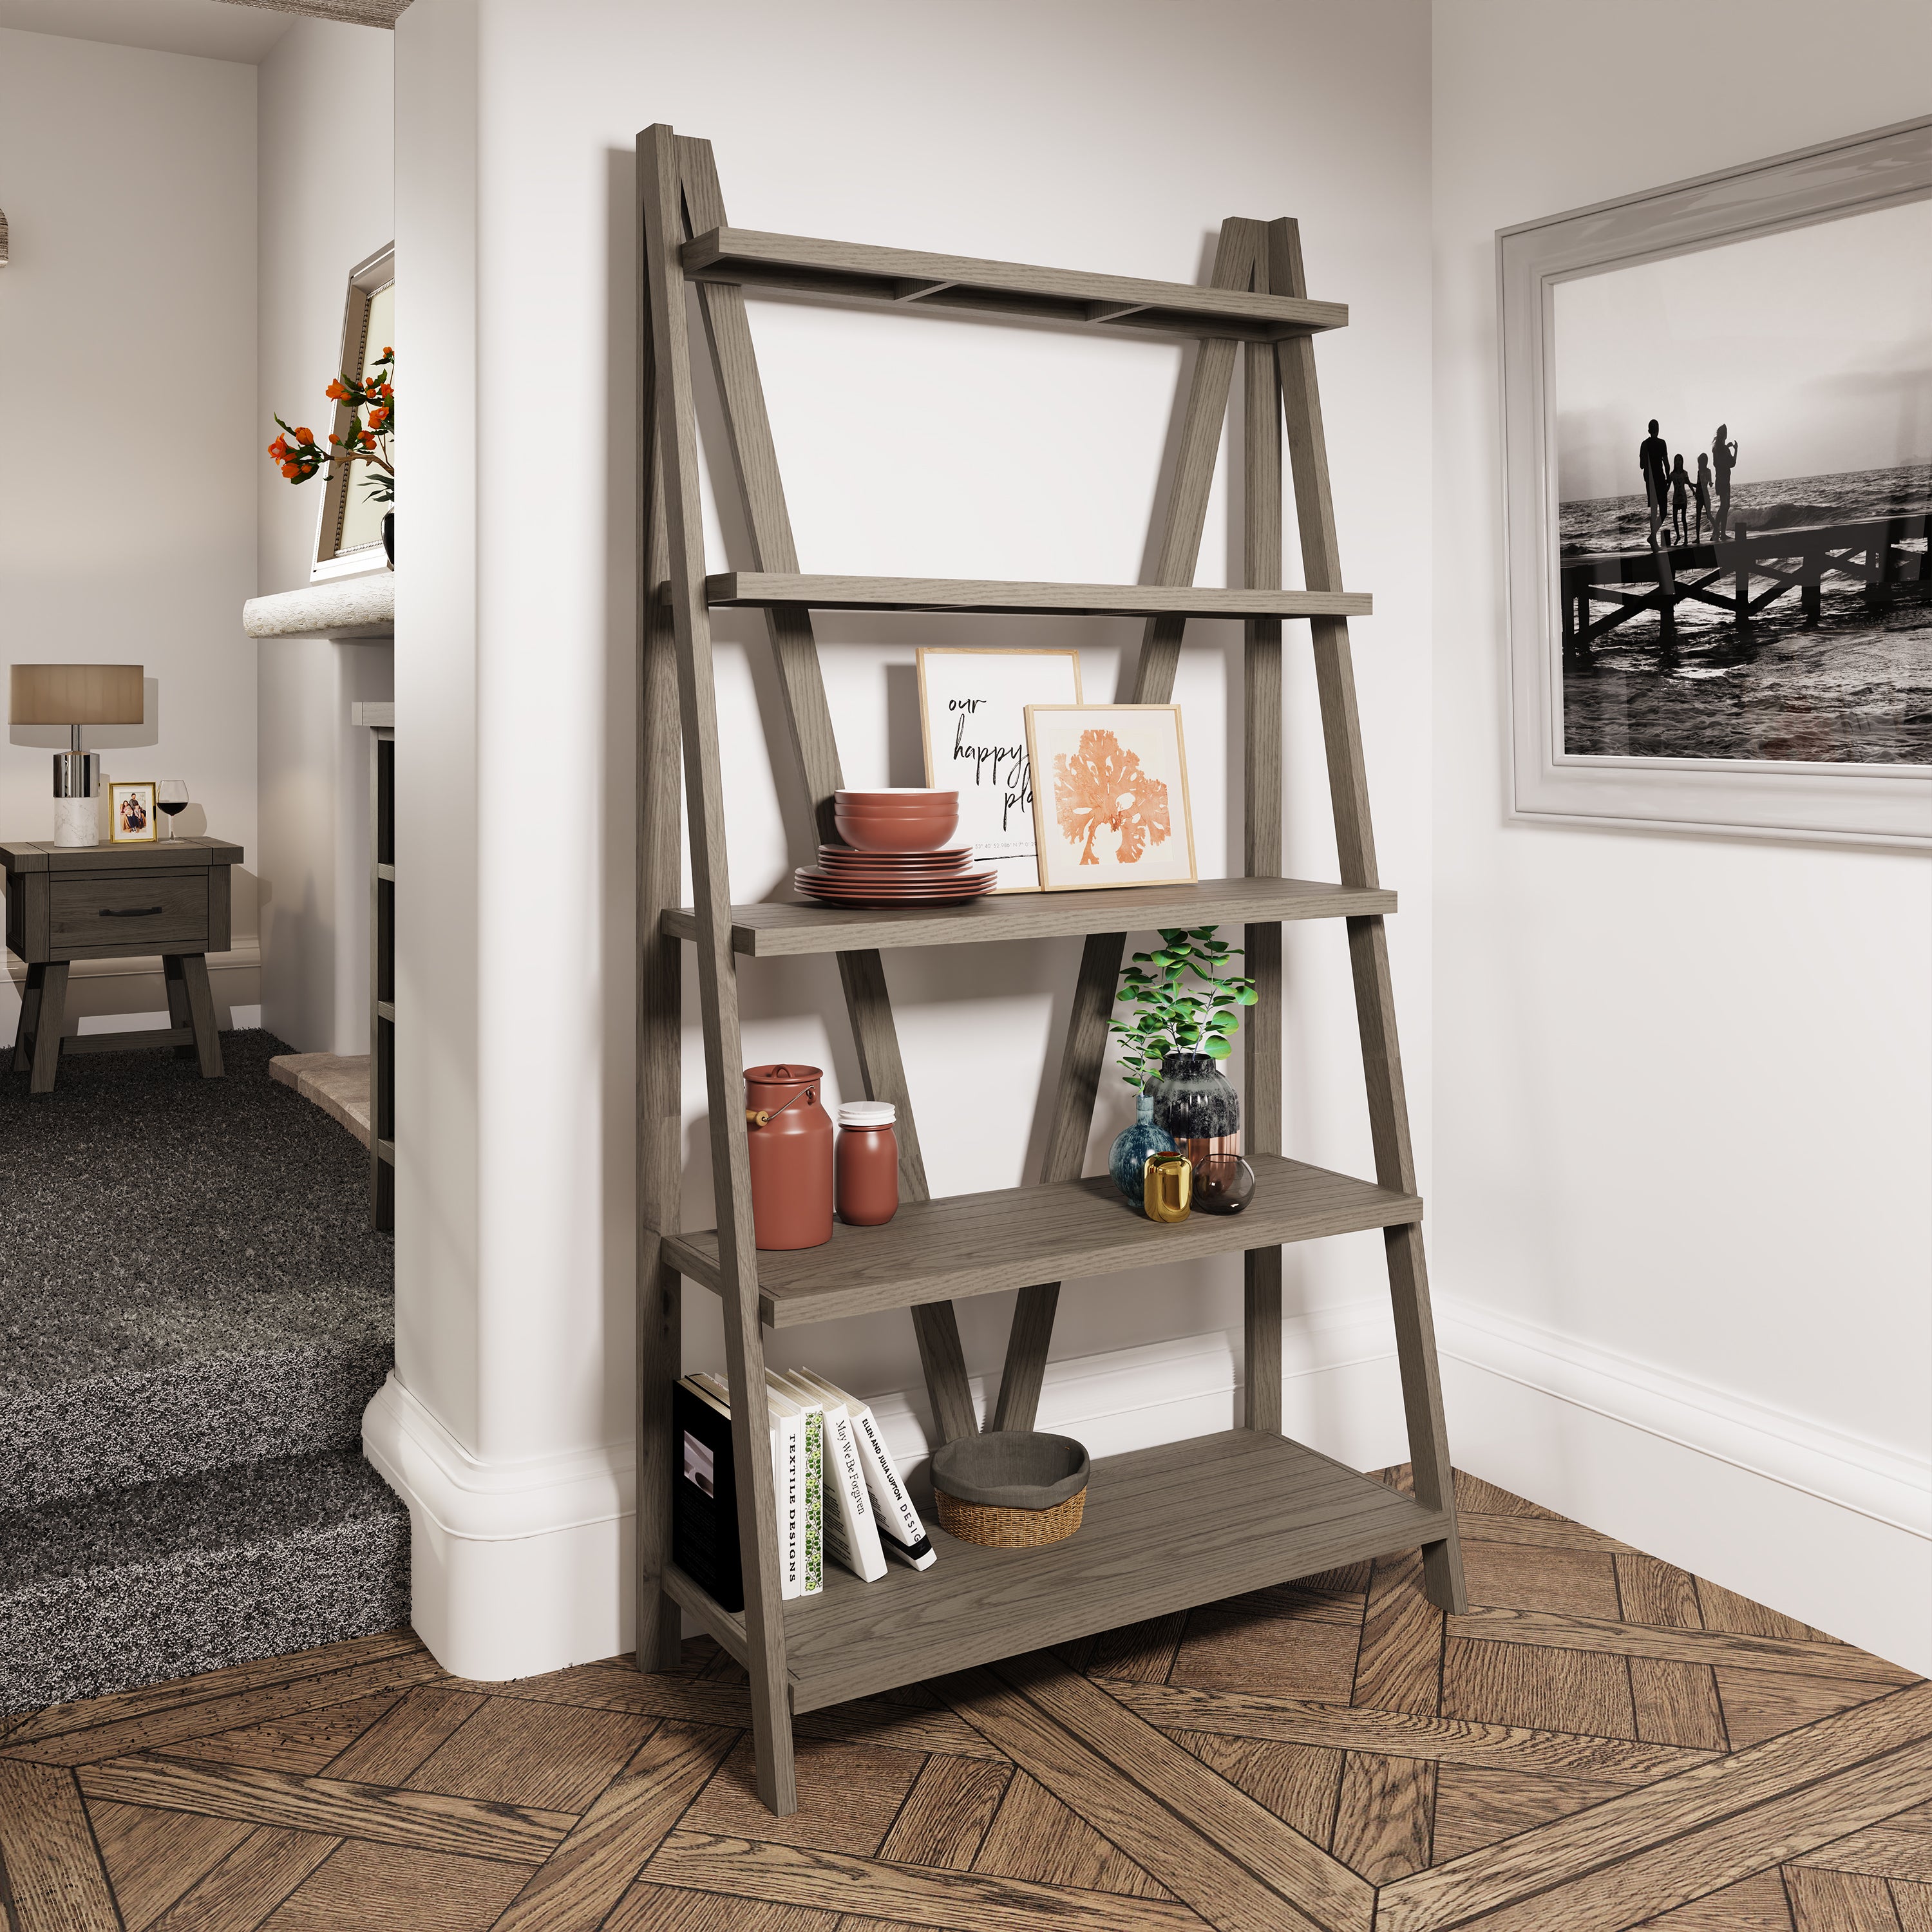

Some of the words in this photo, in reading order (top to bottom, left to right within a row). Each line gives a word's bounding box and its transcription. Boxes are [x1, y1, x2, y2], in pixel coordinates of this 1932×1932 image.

[949, 699, 987, 714] our
[953, 714, 1029, 788] happy
[836, 1419, 847, 1441] May
[842, 1441, 852, 1459] We
[862, 1418, 875, 1439] ELLEN
[871, 1439, 881, 1454] AND
[878, 1455, 890, 1474] JULIA
[887, 1473, 902, 1501] LUPTON
[846, 1459, 855, 1473] Be
[849, 1473, 865, 1515] Forgiven
